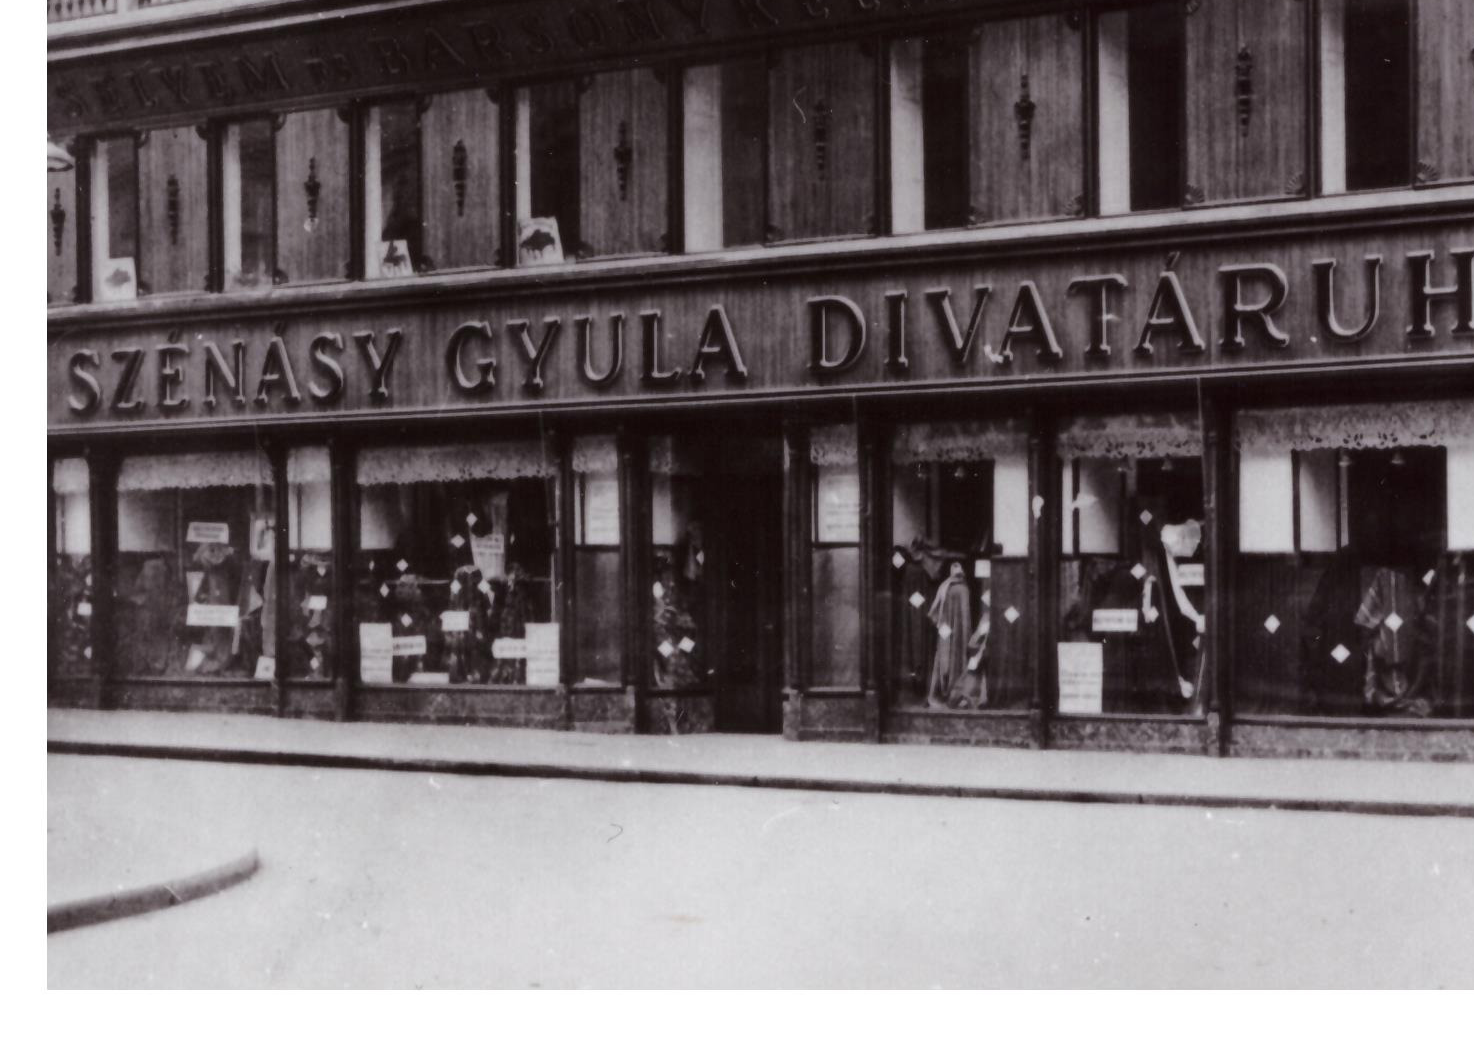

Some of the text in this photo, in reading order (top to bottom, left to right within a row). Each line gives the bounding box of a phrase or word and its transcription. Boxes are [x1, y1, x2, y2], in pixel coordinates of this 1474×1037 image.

[54, 49, 291, 118] SELYEM
[66, 322, 403, 415] SZÉNÁSY
[446, 303, 749, 392] GYULA
